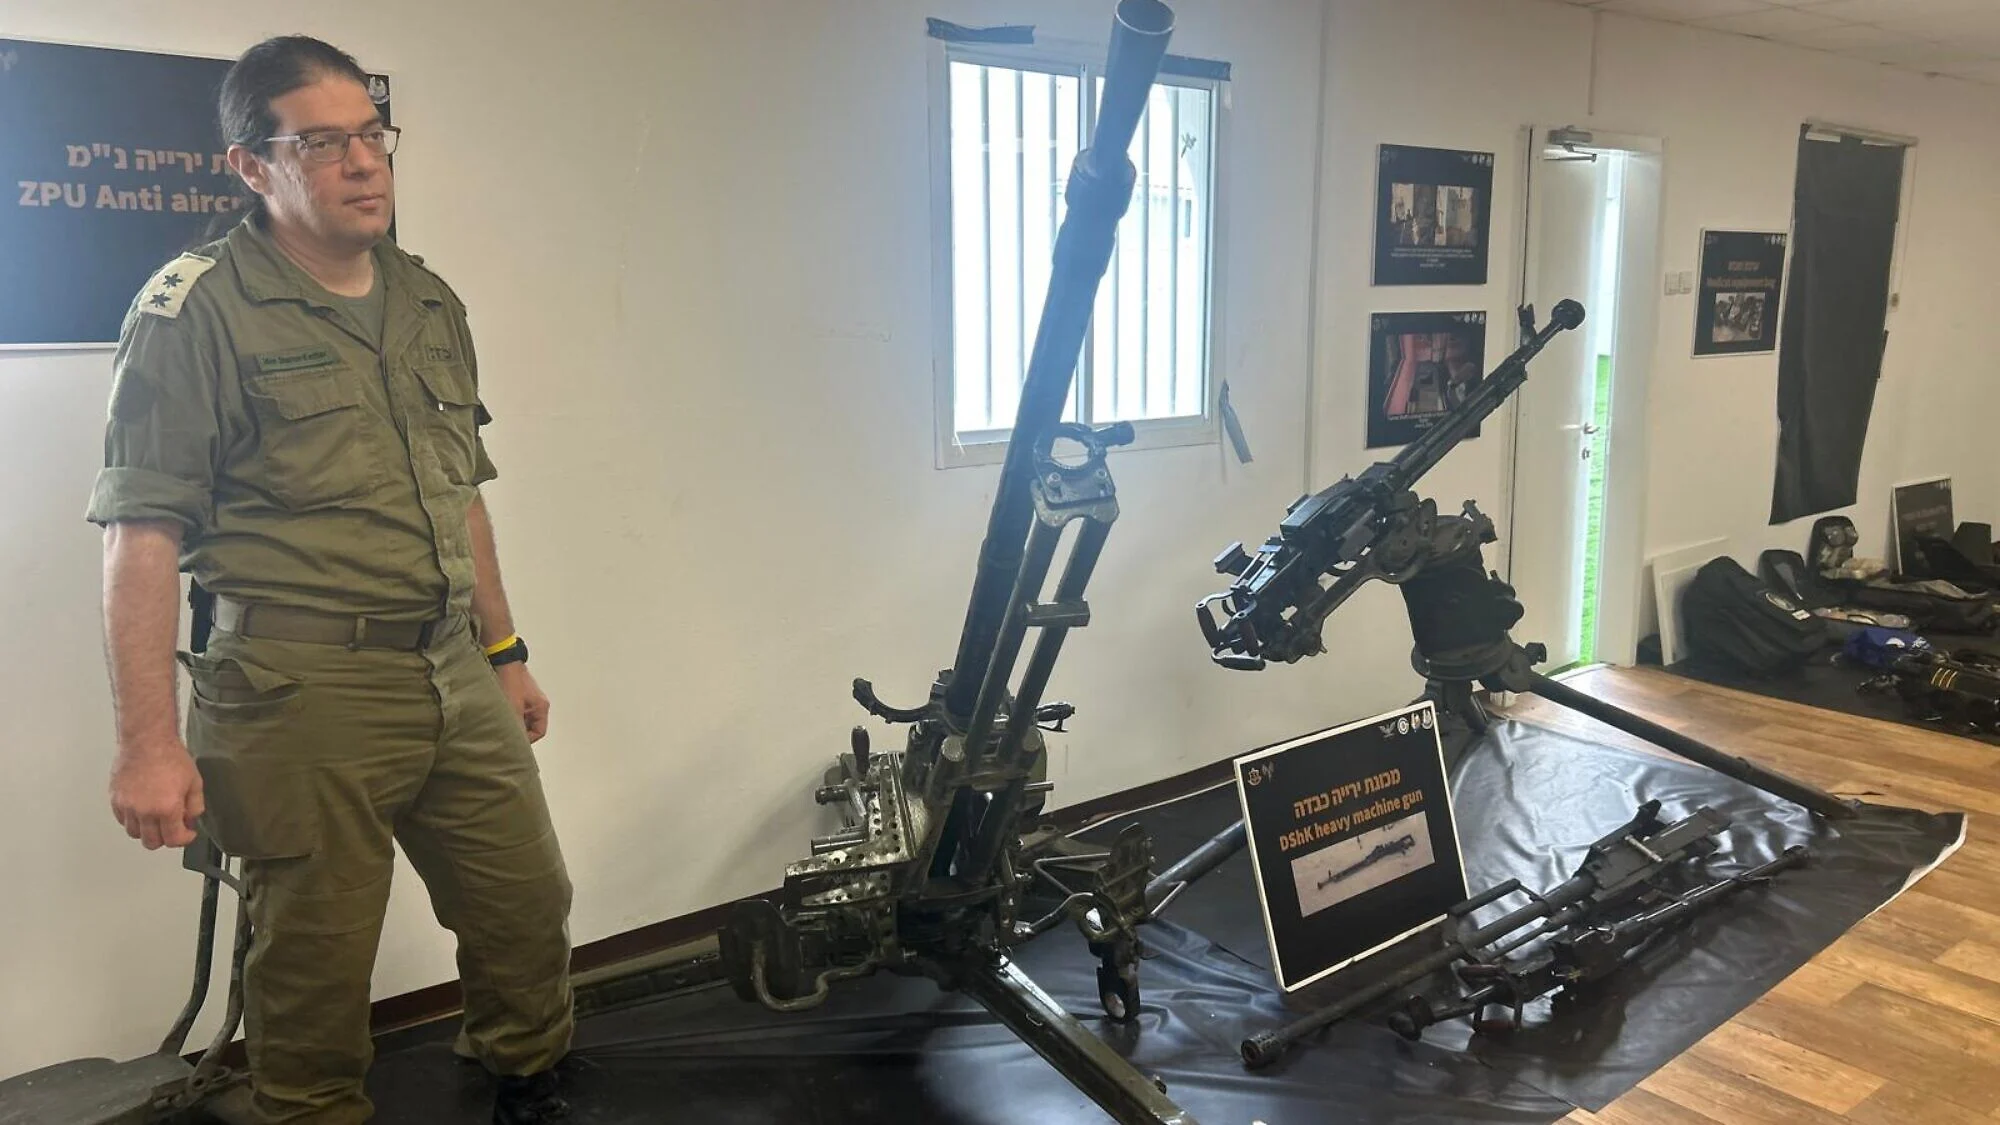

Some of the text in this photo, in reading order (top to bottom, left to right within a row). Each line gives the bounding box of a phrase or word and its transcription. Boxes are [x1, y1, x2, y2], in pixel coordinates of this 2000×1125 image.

[135, 149, 203, 173] ירייה
[18, 180, 241, 213] ZPU Anti aircr
[1293, 768, 1401, 819] מכונת ירייה כבדה
[1279, 789, 1423, 851] DShK heavy machine gun
